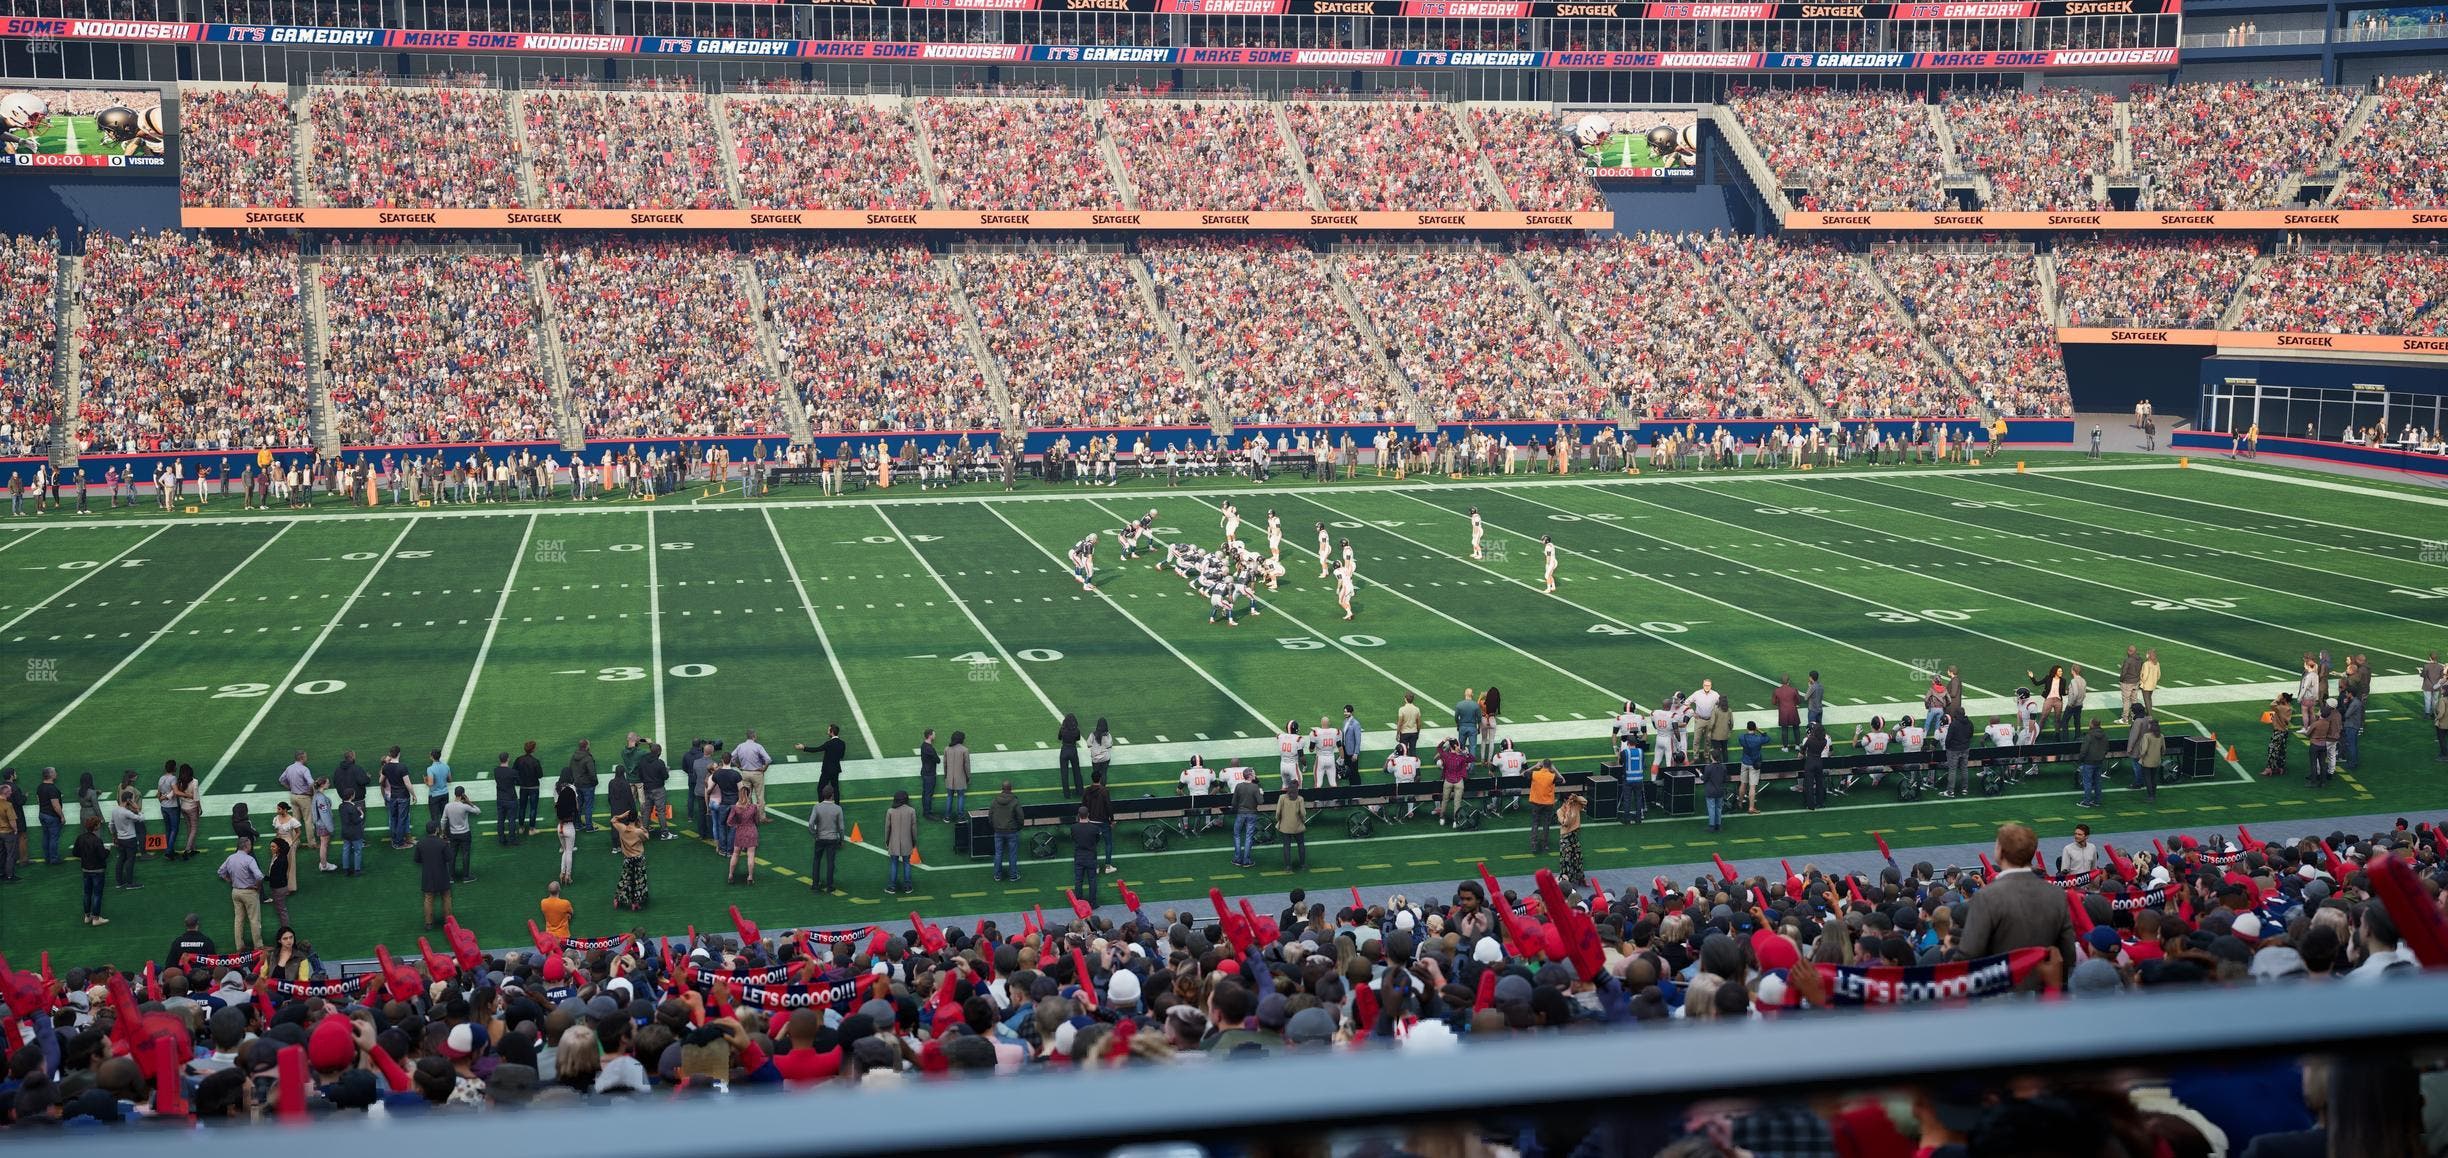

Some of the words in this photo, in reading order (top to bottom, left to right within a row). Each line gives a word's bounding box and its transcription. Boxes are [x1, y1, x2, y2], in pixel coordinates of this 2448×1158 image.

[1067, 0, 1129, 10] SEATGEEK
[1176, 0, 1200, 10] IT'S
[1204, 0, 1275, 12] GAMEDAY!
[1314, 2, 1375, 14] SEATGEEK
[1420, 3, 1446, 14] IT'S
[1449, 2, 1519, 16] GAMEDAY!
[1557, 4, 1618, 16] SEATGEEK
[1663, 4, 1690, 16] IT'S
[1692, 4, 1763, 18] GAMEDAY!
[1802, 4, 1864, 18] SEATGEEK
[1910, 5, 1940, 16] IT'S
[1944, 4, 2023, 18] GAMEDAY!
[2065, 0, 2133, 14] SEATGEEK
[7, 20, 68, 34] SOME
[72, 21, 190, 40] NOOOOISE!!!
[227, 27, 266, 41] IT'S
[271, 28, 374, 44] GAMEDAY!
[403, 32, 461, 46] MAKE
[467, 34, 518, 48] SOME
[523, 35, 625, 52] NOOOOISE!!!
[658, 39, 692, 53] IT'S
[696, 39, 788, 56] GAMEDAY!
[814, 42, 867, 56] MAKE
[872, 44, 920, 57] SOME
[923, 44, 1016, 60] NOOOOISE!!!
[1047, 47, 1079, 60] IT'S
[1083, 47, 1169, 62] GAMEDAY!
[1193, 49, 1240, 62] MAKE
[1248, 50, 1293, 62] SOME
[1296, 50, 1386, 64] NOOOOISE!!!
[1415, 52, 1446, 64] IT'S
[1451, 52, 1535, 66] GAMEDAY!
[1558, 53, 1606, 66] MAKE
[1612, 54, 1658, 66] SOME
[1661, 54, 1750, 67] NOOOOISE!!!
[1781, 54, 1812, 66] IT'S
[1816, 53, 1904, 66] GAMEDAY!
[1930, 53, 1988, 66] MAKE
[1995, 52, 2048, 65] SOME
[2052, 50, 2173, 66] NOOOOISE!!!
[18, 155, 30, 164] 0
[36, 156, 84, 165] 00:00
[114, 156, 121, 165] 0
[128, 158, 164, 166] VISITORS
[1600, 168, 1634, 176] 00:00
[246, 212, 305, 224] SEATGEEK
[379, 212, 436, 224] SEATGEEK
[508, 212, 562, 224] SEATGEEK
[630, 213, 684, 224] SEATGEEK
[750, 214, 802, 224] SEATGEEK
[866, 214, 917, 224] SEATGEEK
[980, 214, 1030, 224] SEATGEEK
[1092, 214, 1140, 224] SEATGEEK
[1202, 214, 1250, 225] SEATGEEK
[1310, 214, 1358, 226] SEATGEEK
[1418, 214, 1466, 226] SEATGEEK
[1526, 214, 1573, 226] SEATGEEK
[1822, 214, 1871, 226] SEATGEEK
[1934, 214, 1984, 226] SEATGEEK
[2048, 214, 2100, 225] SEATGEEK
[2161, 214, 2214, 225] SEATGEEK
[2284, 214, 2339, 224] SEATGEEK
[2112, 331, 2168, 342] SEATGEEK
[2277, 336, 2332, 347] SEATGEEK
[2130, 597, 2237, 610] 20
[1864, 608, 1972, 623] 30
[1586, 621, 1689, 636] 40
[1275, 634, 1386, 650] 50
[596, 663, 718, 682] 30
[210, 679, 348, 699] 20
[148, 836, 162, 848] 20
[2112, 890, 2165, 911] GOOOOO!!!
[810, 932, 828, 942] LET'S
[828, 928, 866, 943] GOOOOO!!!
[566, 938, 584, 950] LET'S
[584, 937, 620, 950] GOOOOO!!!
[196, 955, 215, 966] LET'S
[277, 982, 304, 996] LET'S
[304, 978, 360, 996] GOOOOO!!!
[1834, 969, 1890, 1004] LET'S
[742, 988, 781, 1008] LET'S
[781, 981, 856, 1008] GOOOOO!!!
